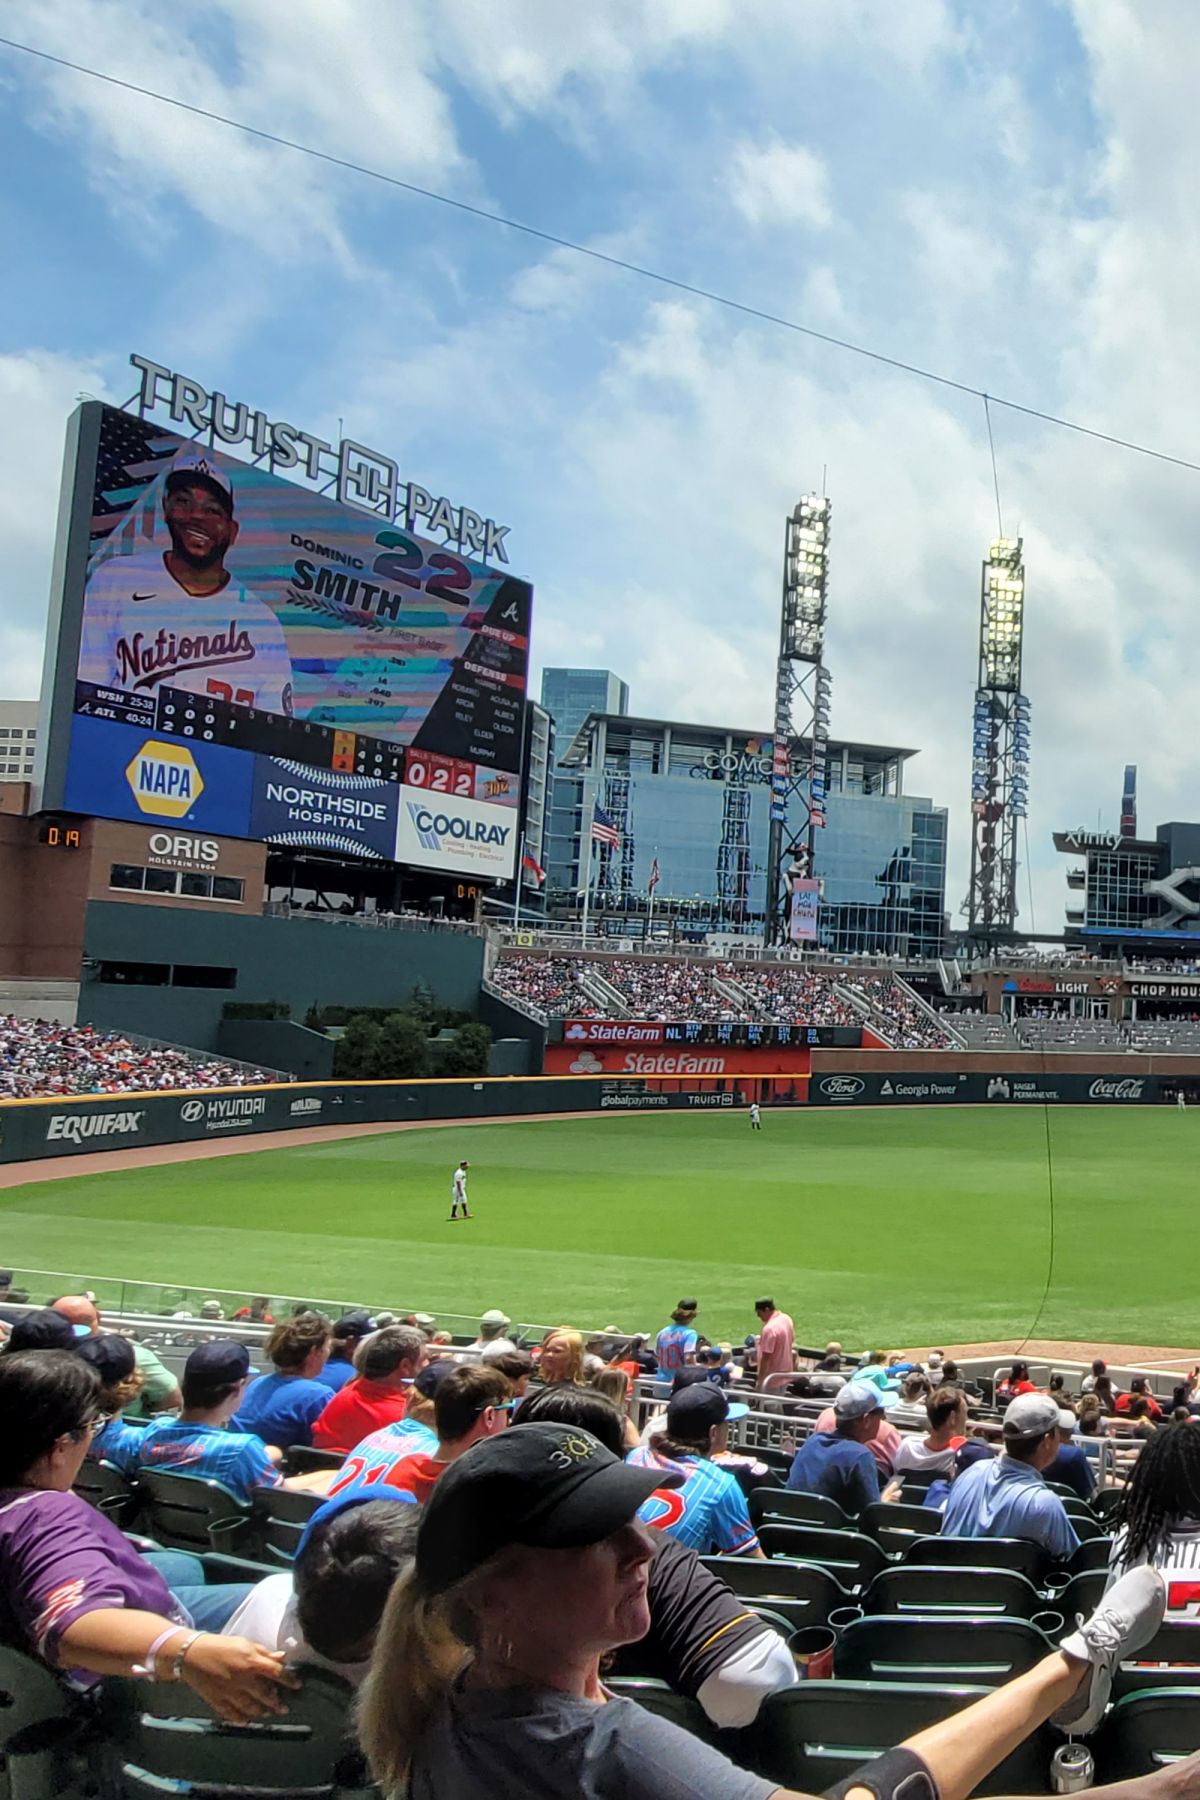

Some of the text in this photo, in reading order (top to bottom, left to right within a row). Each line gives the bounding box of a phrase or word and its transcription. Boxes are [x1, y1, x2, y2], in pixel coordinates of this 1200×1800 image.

[130, 354, 512, 563] TRUIST PARK
[290, 534, 364, 570] DOMINIC
[373, 531, 472, 606] 22
[291, 559, 402, 621] SMITH
[117, 620, 254, 686] Nationals
[97, 689, 125, 703] WSH
[165, 704, 175, 715] 0
[185, 709, 195, 720] 0
[204, 713, 215, 724] 0
[94, 706, 117, 719] ATL
[162, 721, 174, 731] 2
[184, 725, 194, 736] 0
[203, 729, 214, 740] 0
[140, 760, 190, 799] NAPA
[408, 763, 472, 796] 0 2 2
[266, 783, 387, 820] NORTHSIDE
[289, 808, 365, 832] HOSPITAL
[416, 811, 510, 846] COOLRAY
[149, 833, 219, 862] ORIS
[1065, 826, 1124, 851] xfinity
[148, 857, 192, 868] HOLSTEIN
[1056, 983, 1089, 993] LIGHT
[1131, 984, 1166, 996] CHOP
[666, 1027, 682, 1040] NL
[688, 1095, 721, 1105] TRUIST
[828, 1078, 857, 1093] Ford
[896, 1084, 956, 1097] Georgia Power
[1013, 1082, 1036, 1090] KAISER
[207, 1097, 266, 1118] HYUNDAI
[46, 1111, 143, 1144] EQUIFAX
